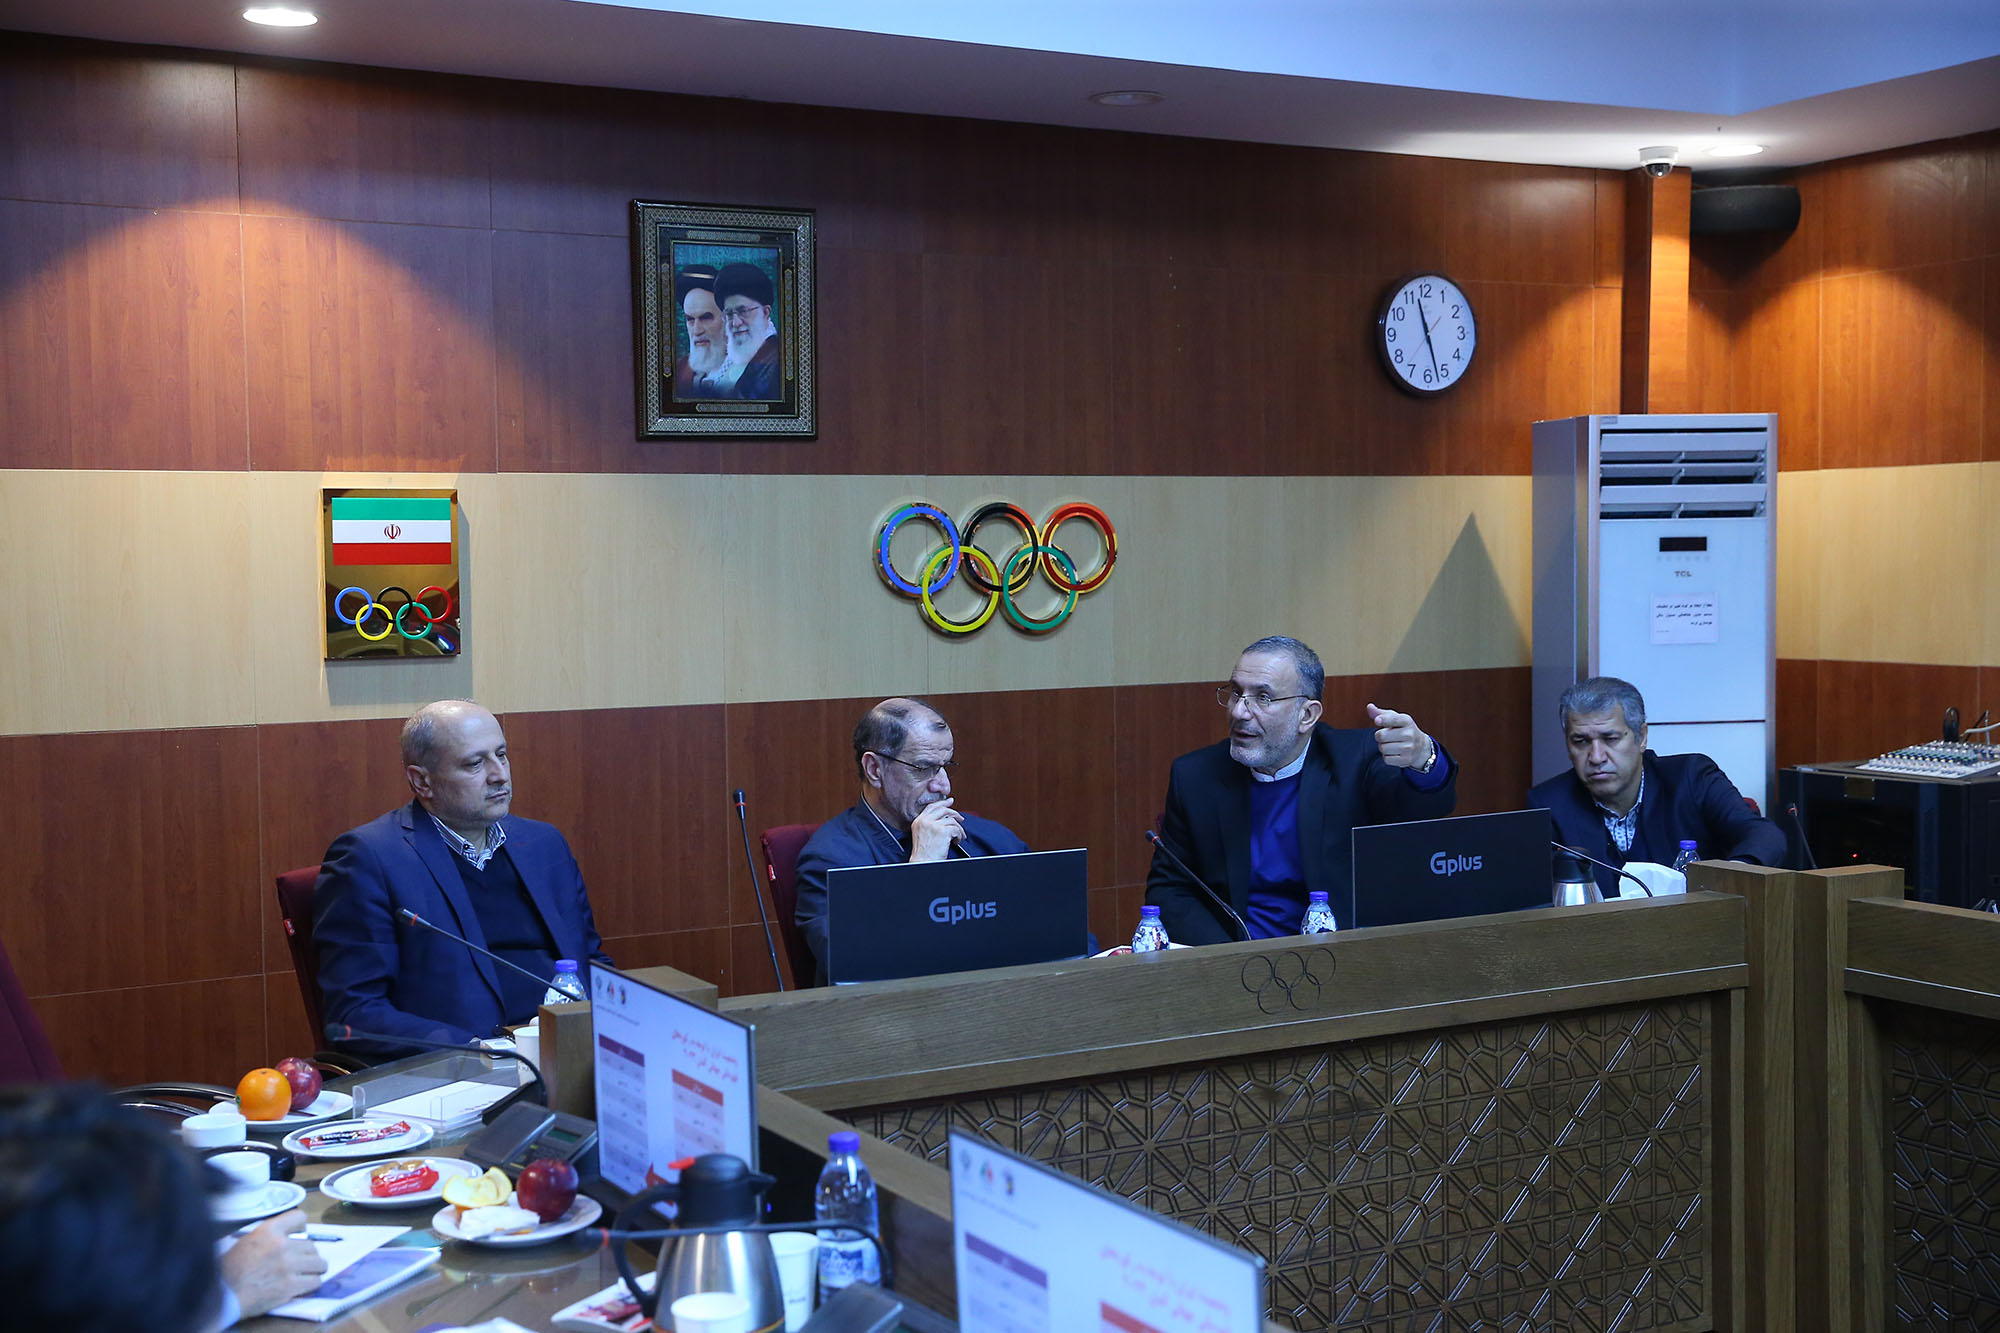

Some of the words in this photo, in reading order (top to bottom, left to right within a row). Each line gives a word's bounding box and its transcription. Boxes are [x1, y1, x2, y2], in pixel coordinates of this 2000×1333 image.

[1404, 290, 1414, 304] 11
[1419, 283, 1432, 298] 12
[1440, 290, 1445, 303] 1
[1391, 306, 1405, 321] 10
[1451, 304, 1460, 319] 2
[1387, 327, 1396, 342] 9
[1457, 325, 1466, 340] 3
[1394, 348, 1403, 363] 8
[1452, 347, 1461, 361] 4
[1407, 363, 1416, 378] 7
[1423, 368, 1432, 383] 6
[1440, 363, 1449, 378] 5
[1430, 851, 1482, 876] Gplus
[928, 896, 997, 925] Gplus
